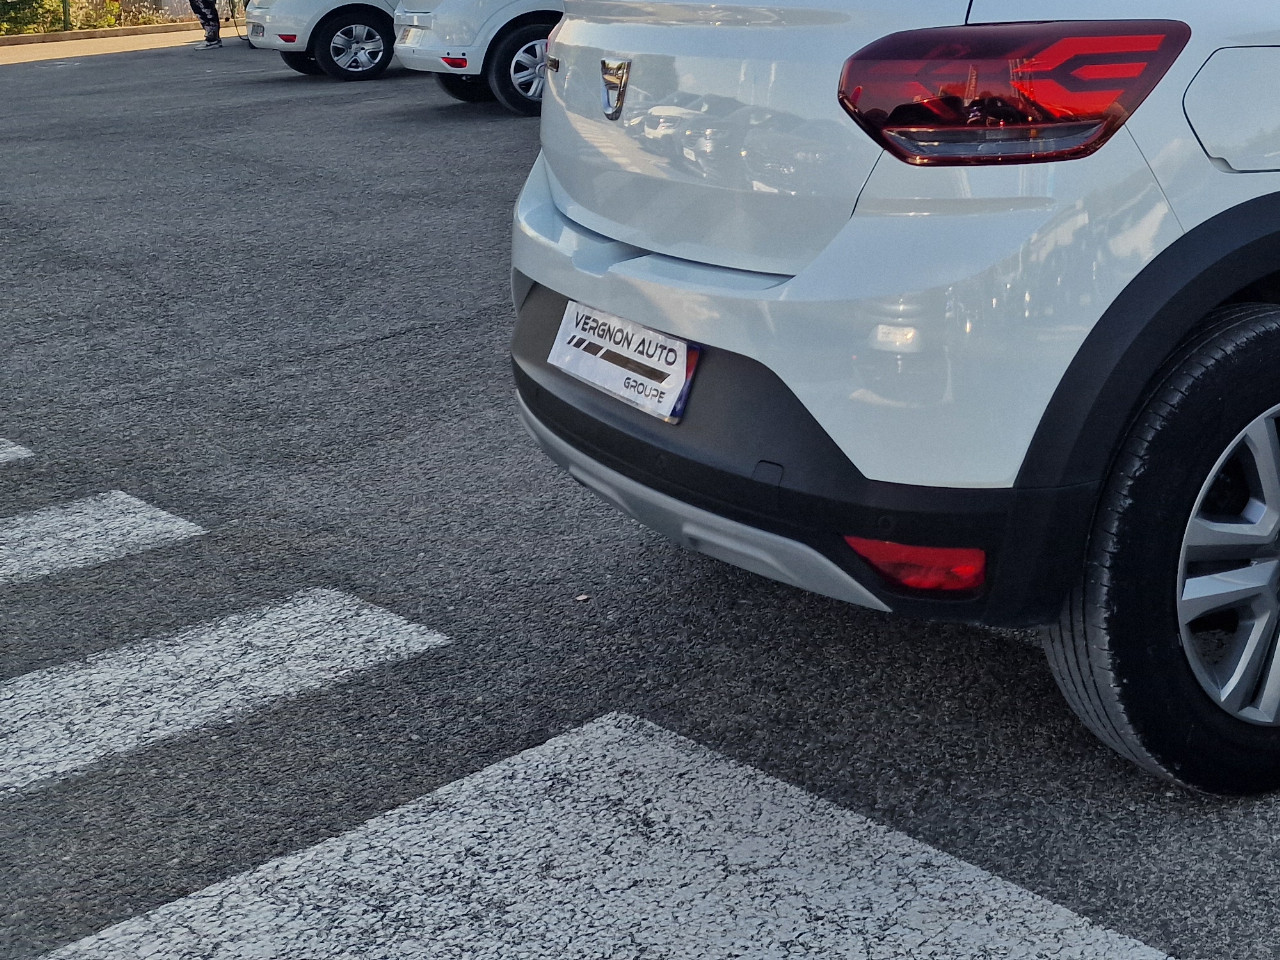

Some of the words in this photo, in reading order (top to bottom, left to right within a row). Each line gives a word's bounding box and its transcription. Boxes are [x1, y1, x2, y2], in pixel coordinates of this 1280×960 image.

[574, 311, 635, 350] VERGNON
[633, 337, 678, 366] AUTO
[623, 377, 666, 404] GROUPE
